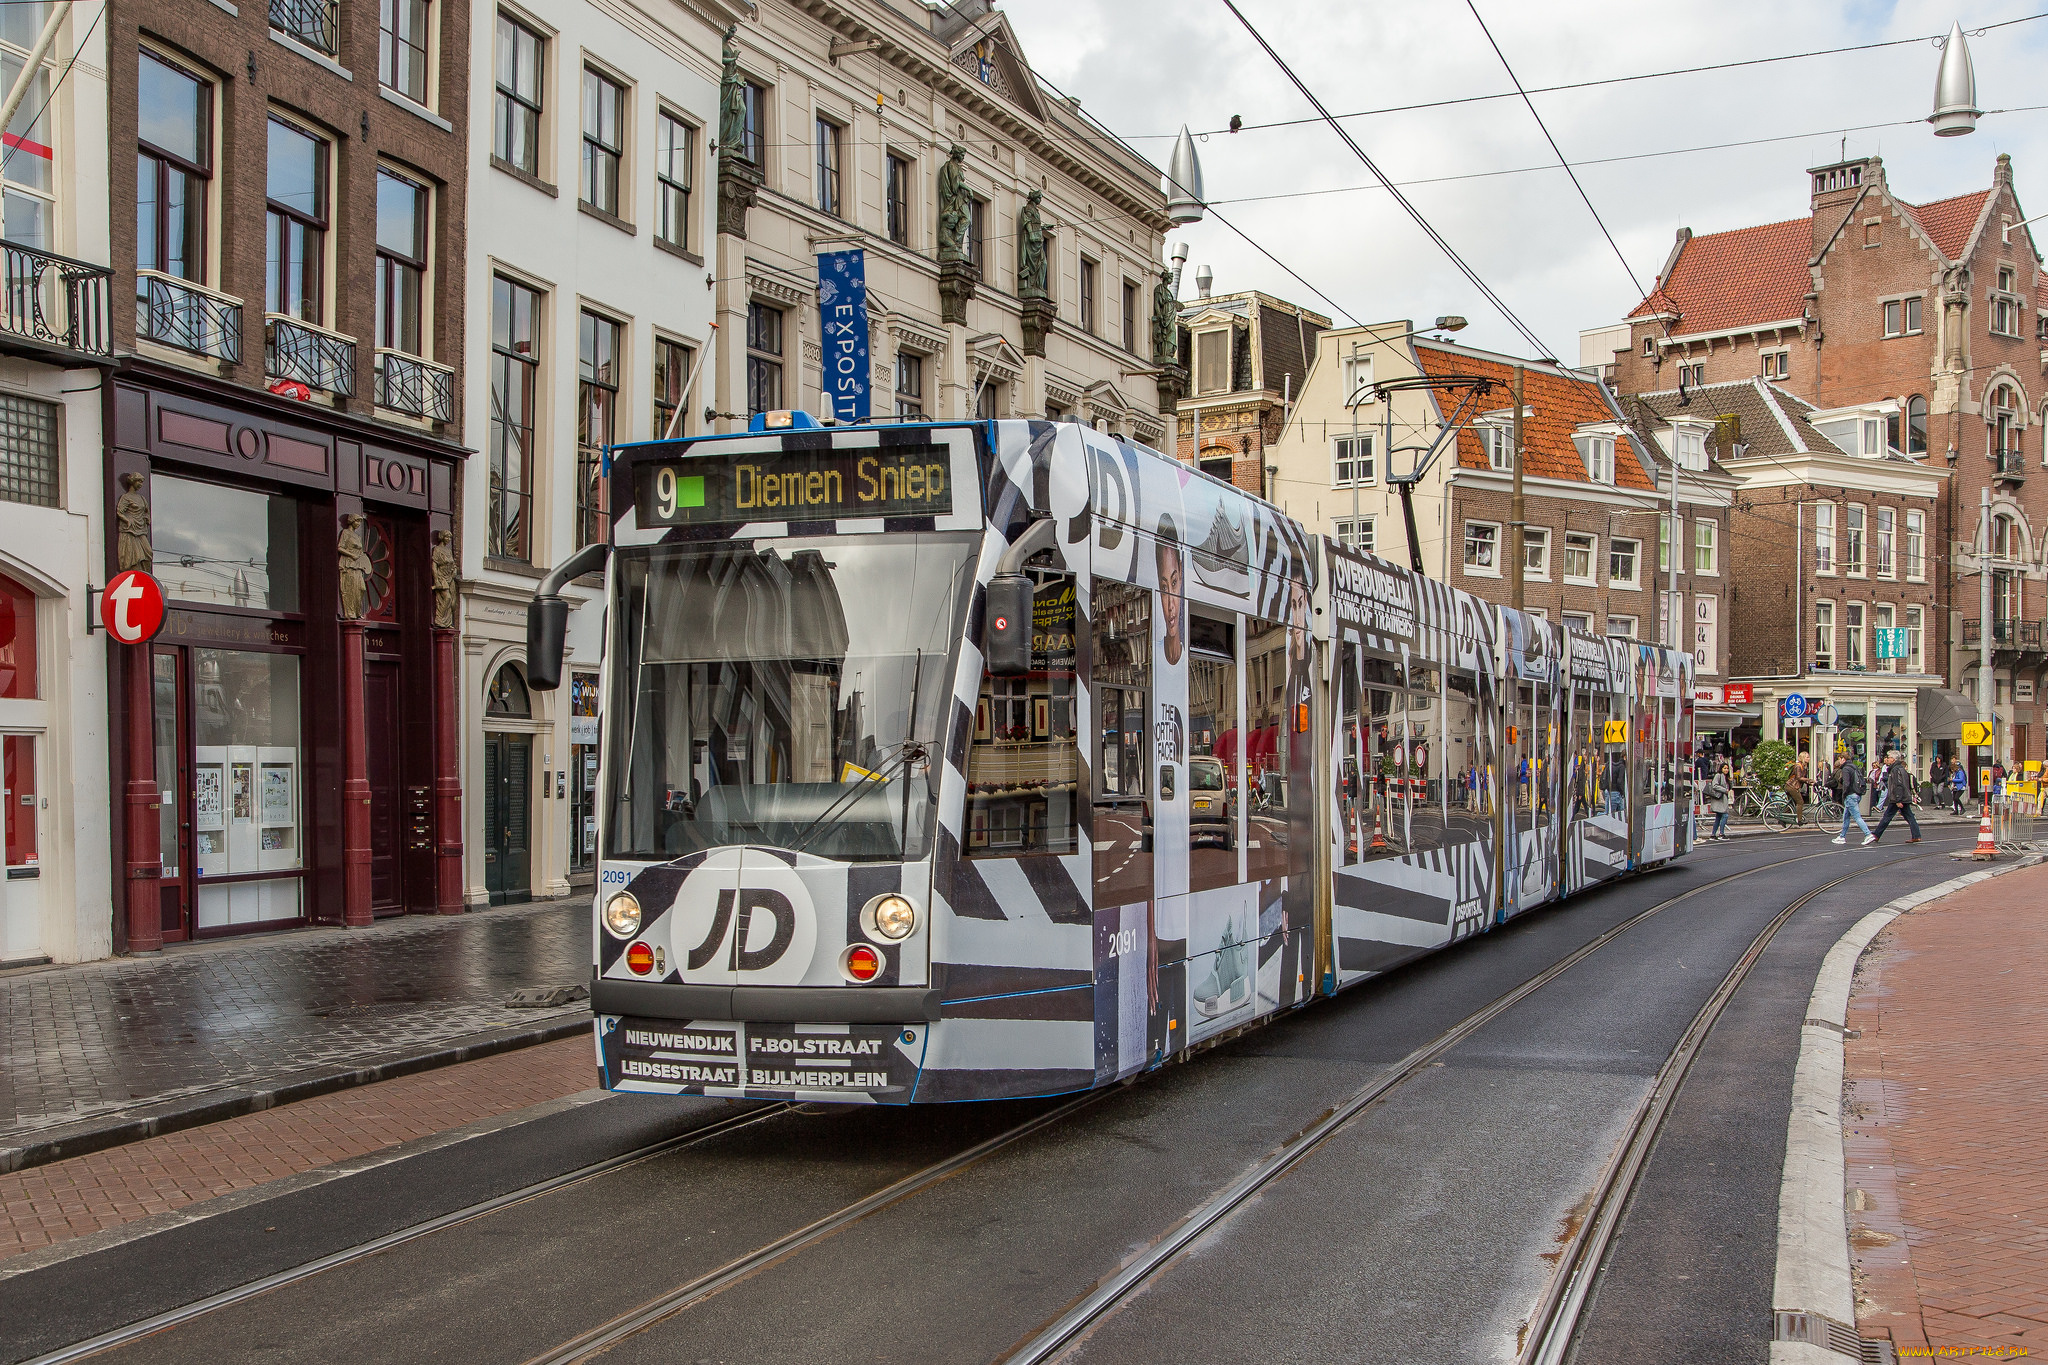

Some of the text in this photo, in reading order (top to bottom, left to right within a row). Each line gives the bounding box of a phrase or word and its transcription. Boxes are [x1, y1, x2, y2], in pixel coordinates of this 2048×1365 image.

[835, 304, 856, 417] EXPOSIT
[656, 456, 944, 519] 9 Diemen Sniep
[1334, 554, 1413, 611] OVERDUIDELIJK
[1337, 589, 1413, 638] KING OF TRAINERS
[1886, 629, 1895, 657] HOTEL
[1161, 703, 1174, 721] THE
[1158, 743, 1175, 762] FACE
[602, 871, 631, 884] 2091
[687, 888, 795, 971] JD
[1108, 928, 1137, 958] 2091
[626, 1029, 734, 1052] NIEUWENDIJK
[750, 1038, 882, 1055] F.BOLSTRAAT
[621, 1060, 735, 1083] LEIDSESTRAAT
[752, 1069, 888, 1087] BIJLMERPLEIN
